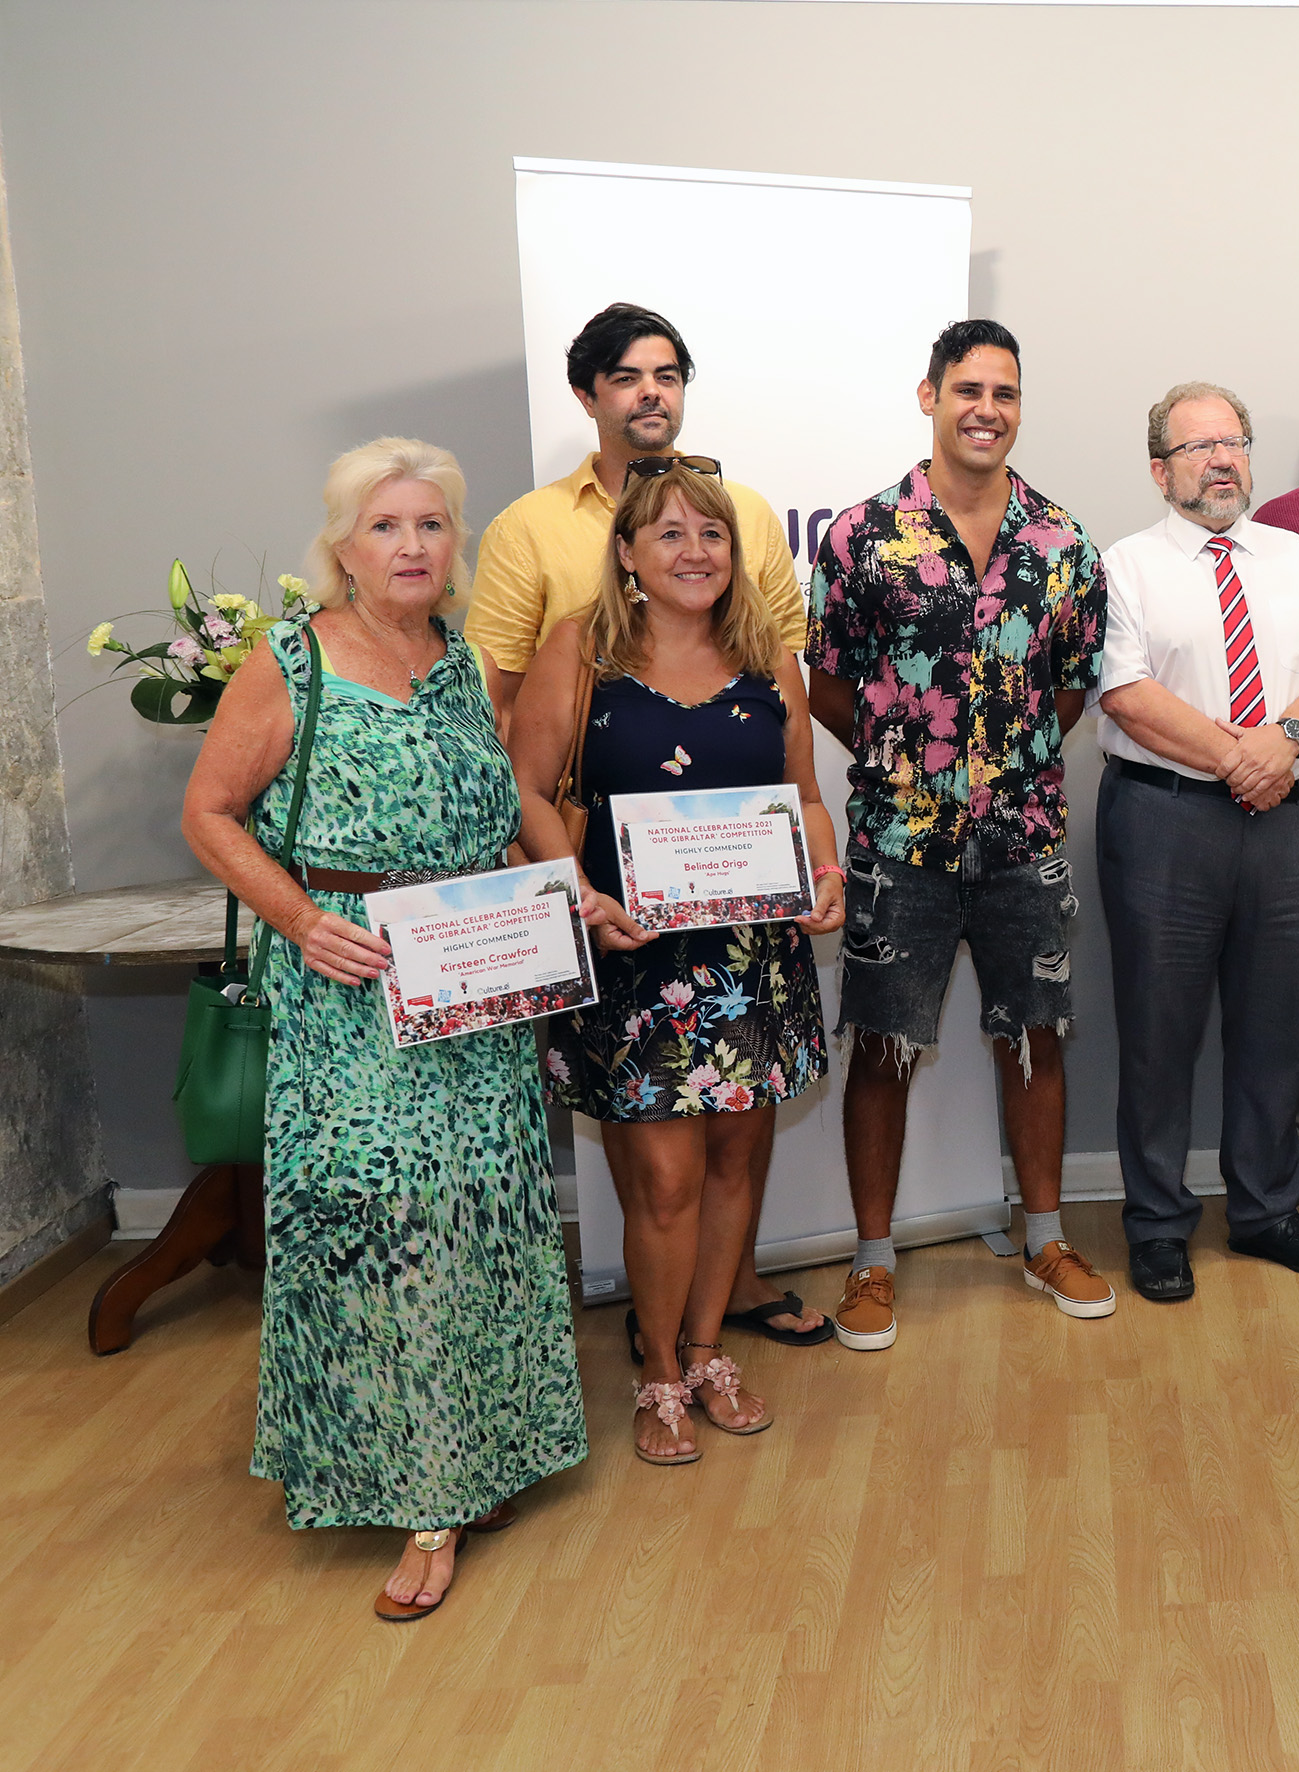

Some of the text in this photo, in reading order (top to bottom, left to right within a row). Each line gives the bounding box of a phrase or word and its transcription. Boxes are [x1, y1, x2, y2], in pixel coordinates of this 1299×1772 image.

[648, 827, 691, 835] NATIONAL
[693, 823, 753, 832] CELEBRATIONS
[721, 830, 772, 838] COMPETITION
[704, 843, 752, 853] COMMENDED
[684, 860, 748, 871] Belinda Origo
[412, 902, 549, 934] NATIONAL CELEBRATIONS 2021
[494, 912, 550, 928] COMPETITION
[443, 930, 529, 952] HIGHLY COMMENDED
[441, 945, 538, 973] Kirsteen Crawford
